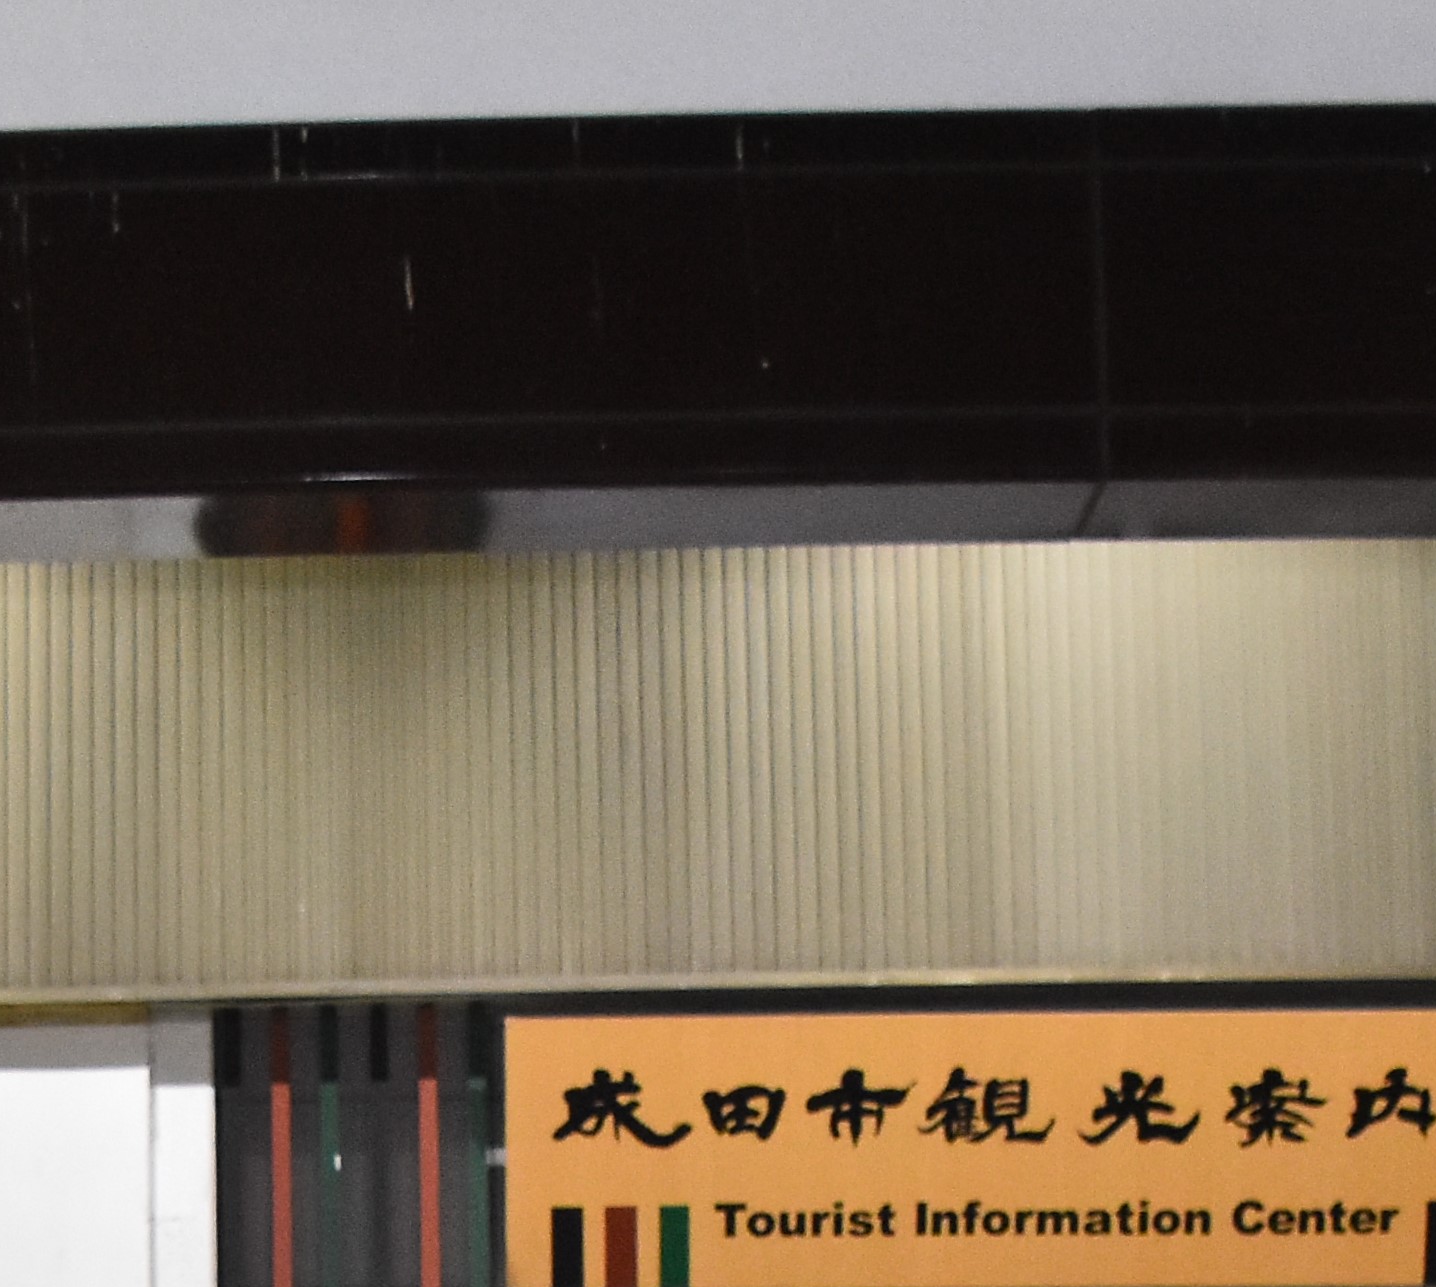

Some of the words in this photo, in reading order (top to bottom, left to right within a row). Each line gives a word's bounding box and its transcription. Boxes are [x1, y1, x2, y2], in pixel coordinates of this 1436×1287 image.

[715, 1200, 897, 1242] Tourist
[916, 1197, 1214, 1240] Information
[1232, 1200, 1401, 1238] Center
